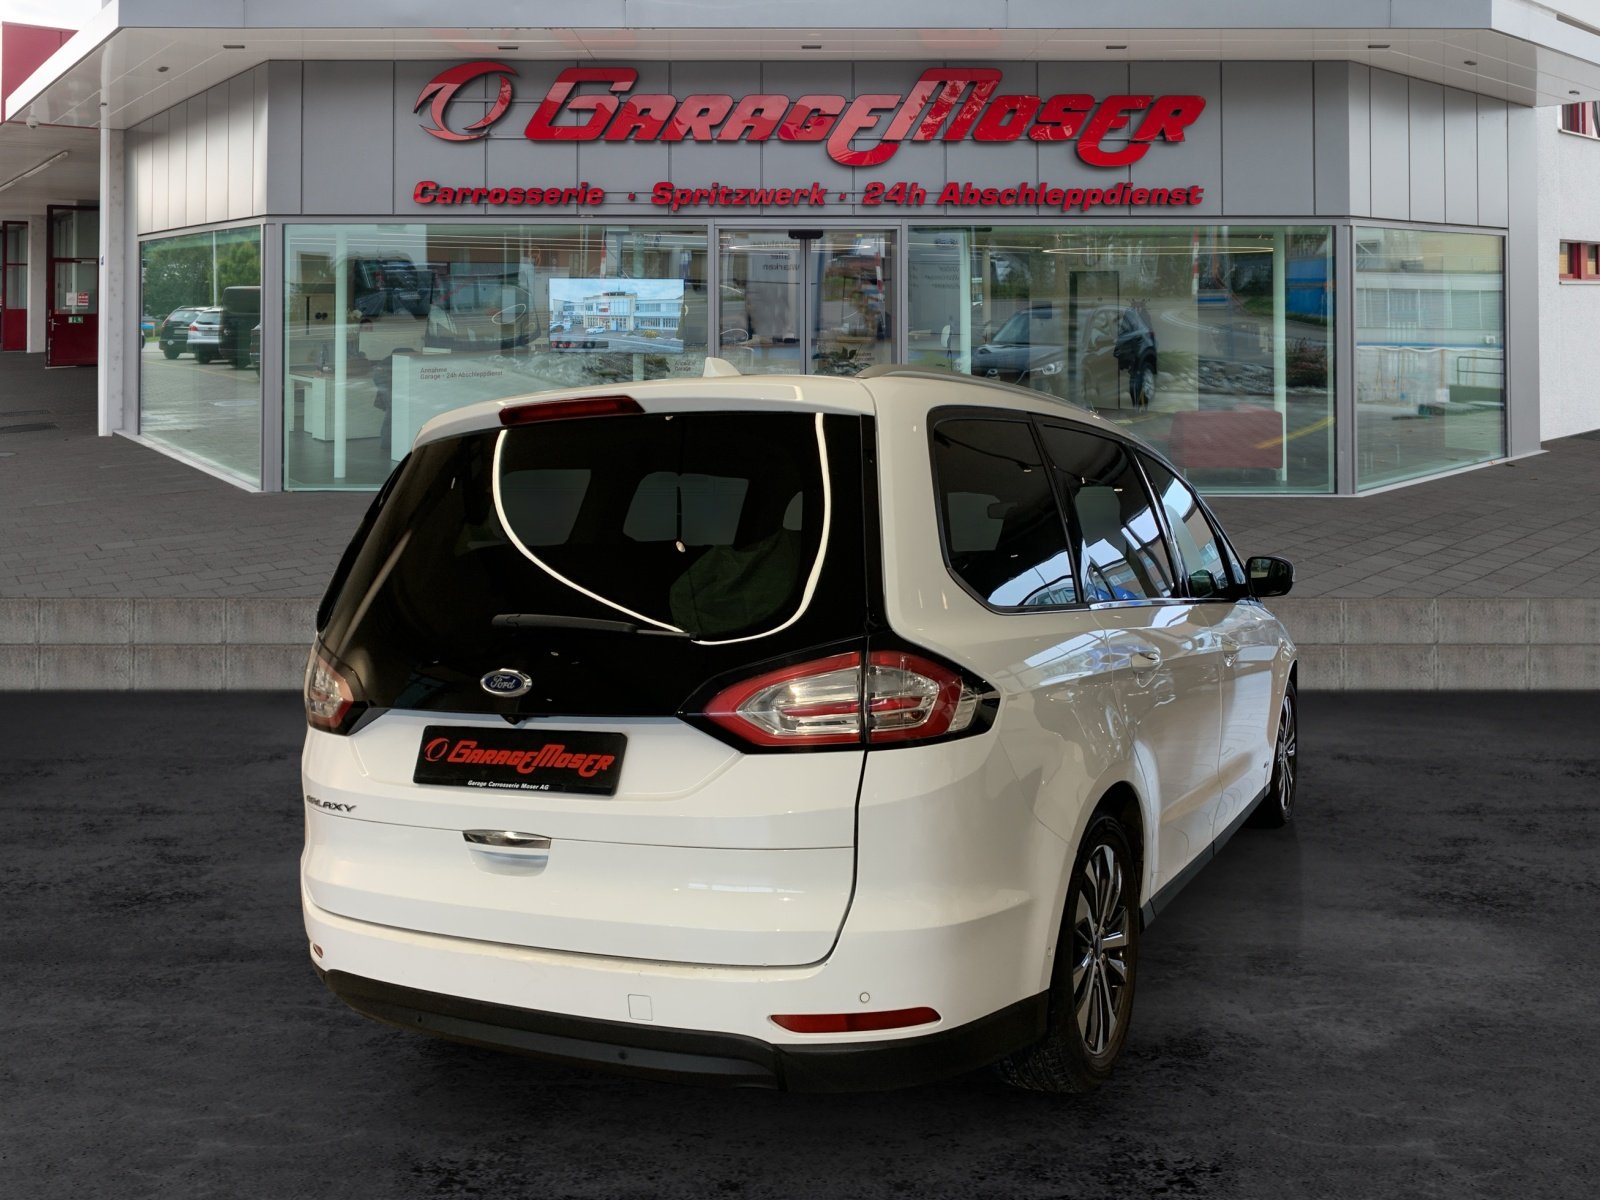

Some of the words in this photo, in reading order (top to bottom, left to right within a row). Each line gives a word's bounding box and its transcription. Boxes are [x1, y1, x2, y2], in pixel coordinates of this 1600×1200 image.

[413, 180, 605, 205] Carrosserie
[651, 181, 827, 211] Spritzwerk
[862, 181, 927, 206] 24h
[936, 181, 1204, 212] Abschleppdienst
[458, 370, 503, 378] Abschleppdienst
[490, 674, 515, 690] Ford
[488, 781, 520, 789] Carrosserie
